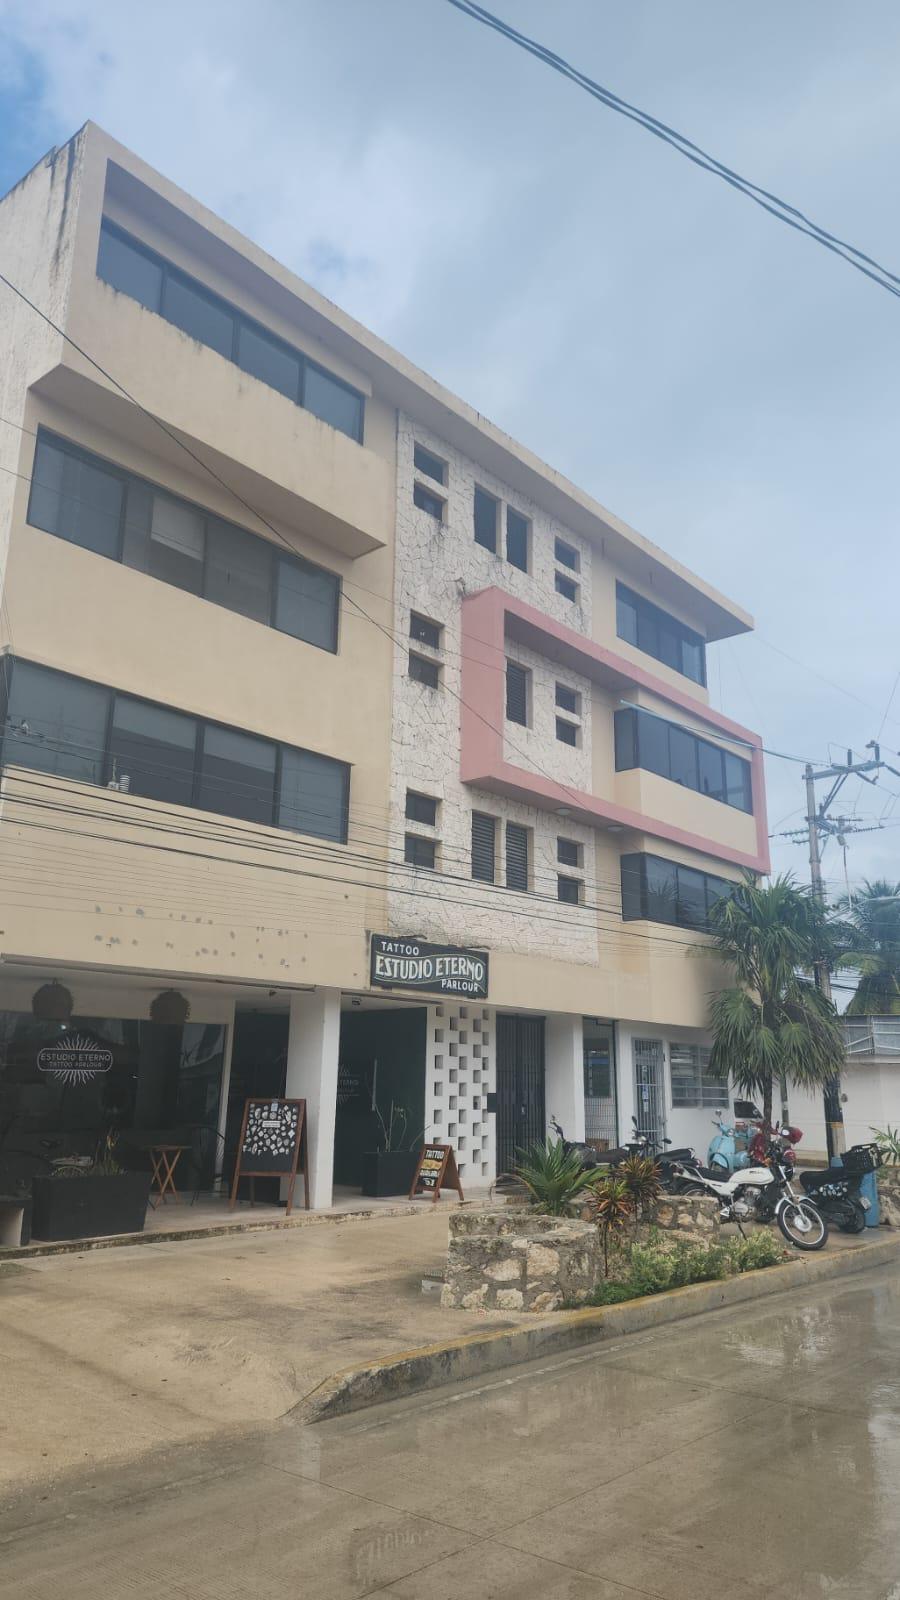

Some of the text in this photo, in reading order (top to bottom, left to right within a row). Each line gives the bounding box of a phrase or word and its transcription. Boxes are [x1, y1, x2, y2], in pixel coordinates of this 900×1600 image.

[381, 941, 420, 956] TATTOO
[375, 955, 483, 981] ESTUDIO ETERNO
[441, 979, 479, 993] PARLOUR
[40, 1053, 111, 1061] ESTUDIO ETERNO
